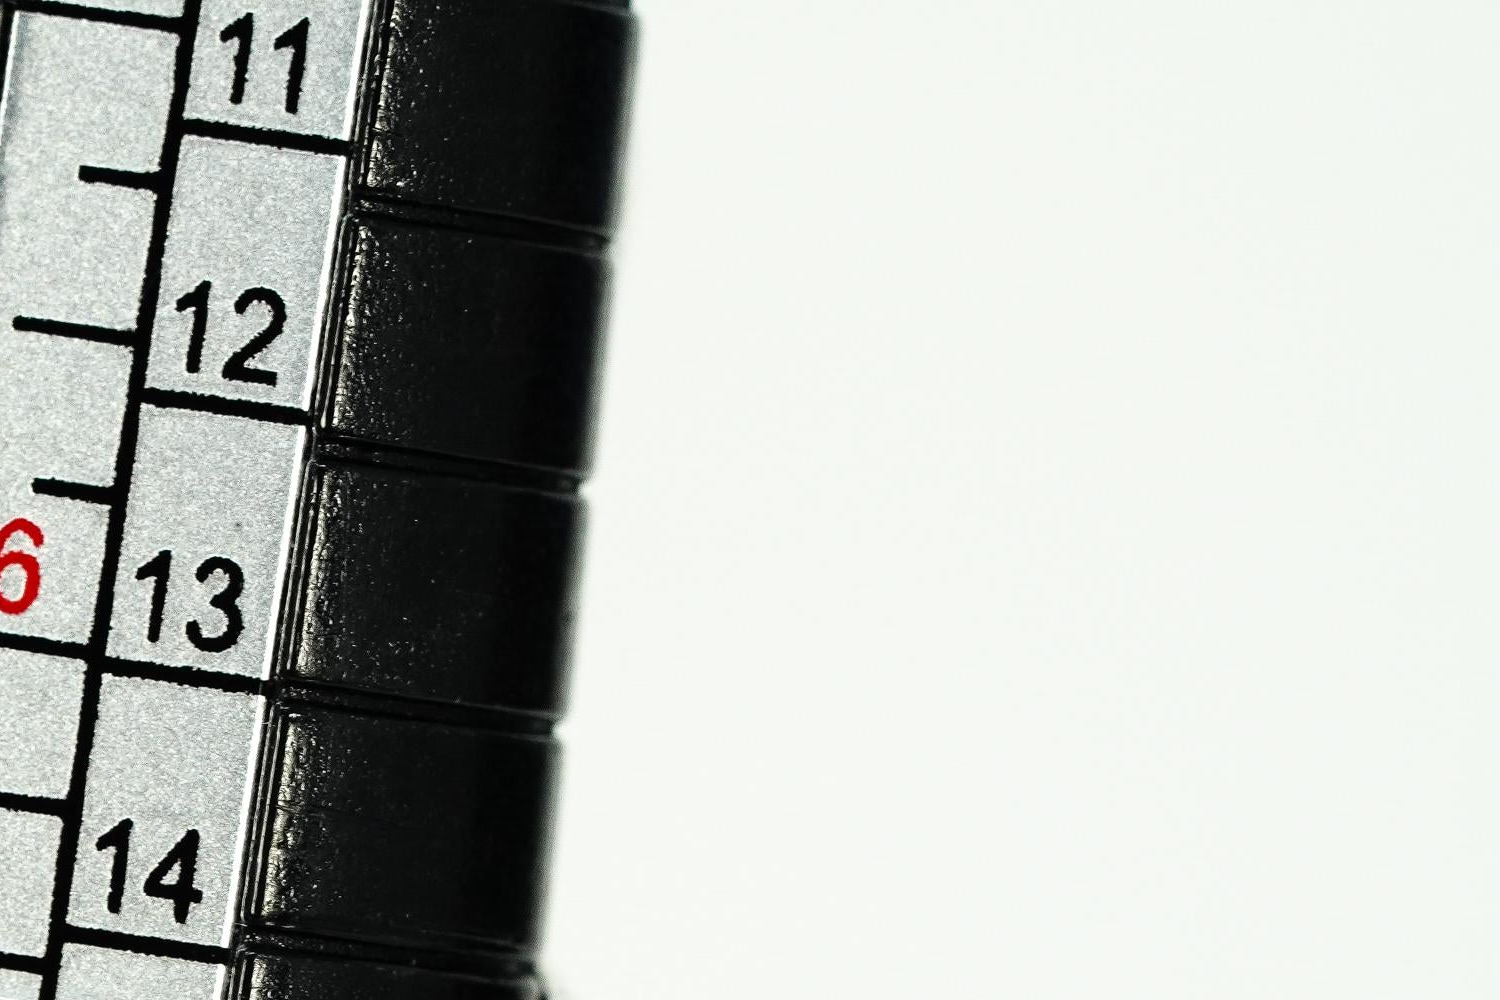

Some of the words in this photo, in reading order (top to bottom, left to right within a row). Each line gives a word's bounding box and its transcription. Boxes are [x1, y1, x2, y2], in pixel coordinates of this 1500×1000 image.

[220, 13, 311, 115] 11
[175, 280, 287, 387] 12
[135, 550, 246, 653] 13
[96, 818, 204, 924] 14
